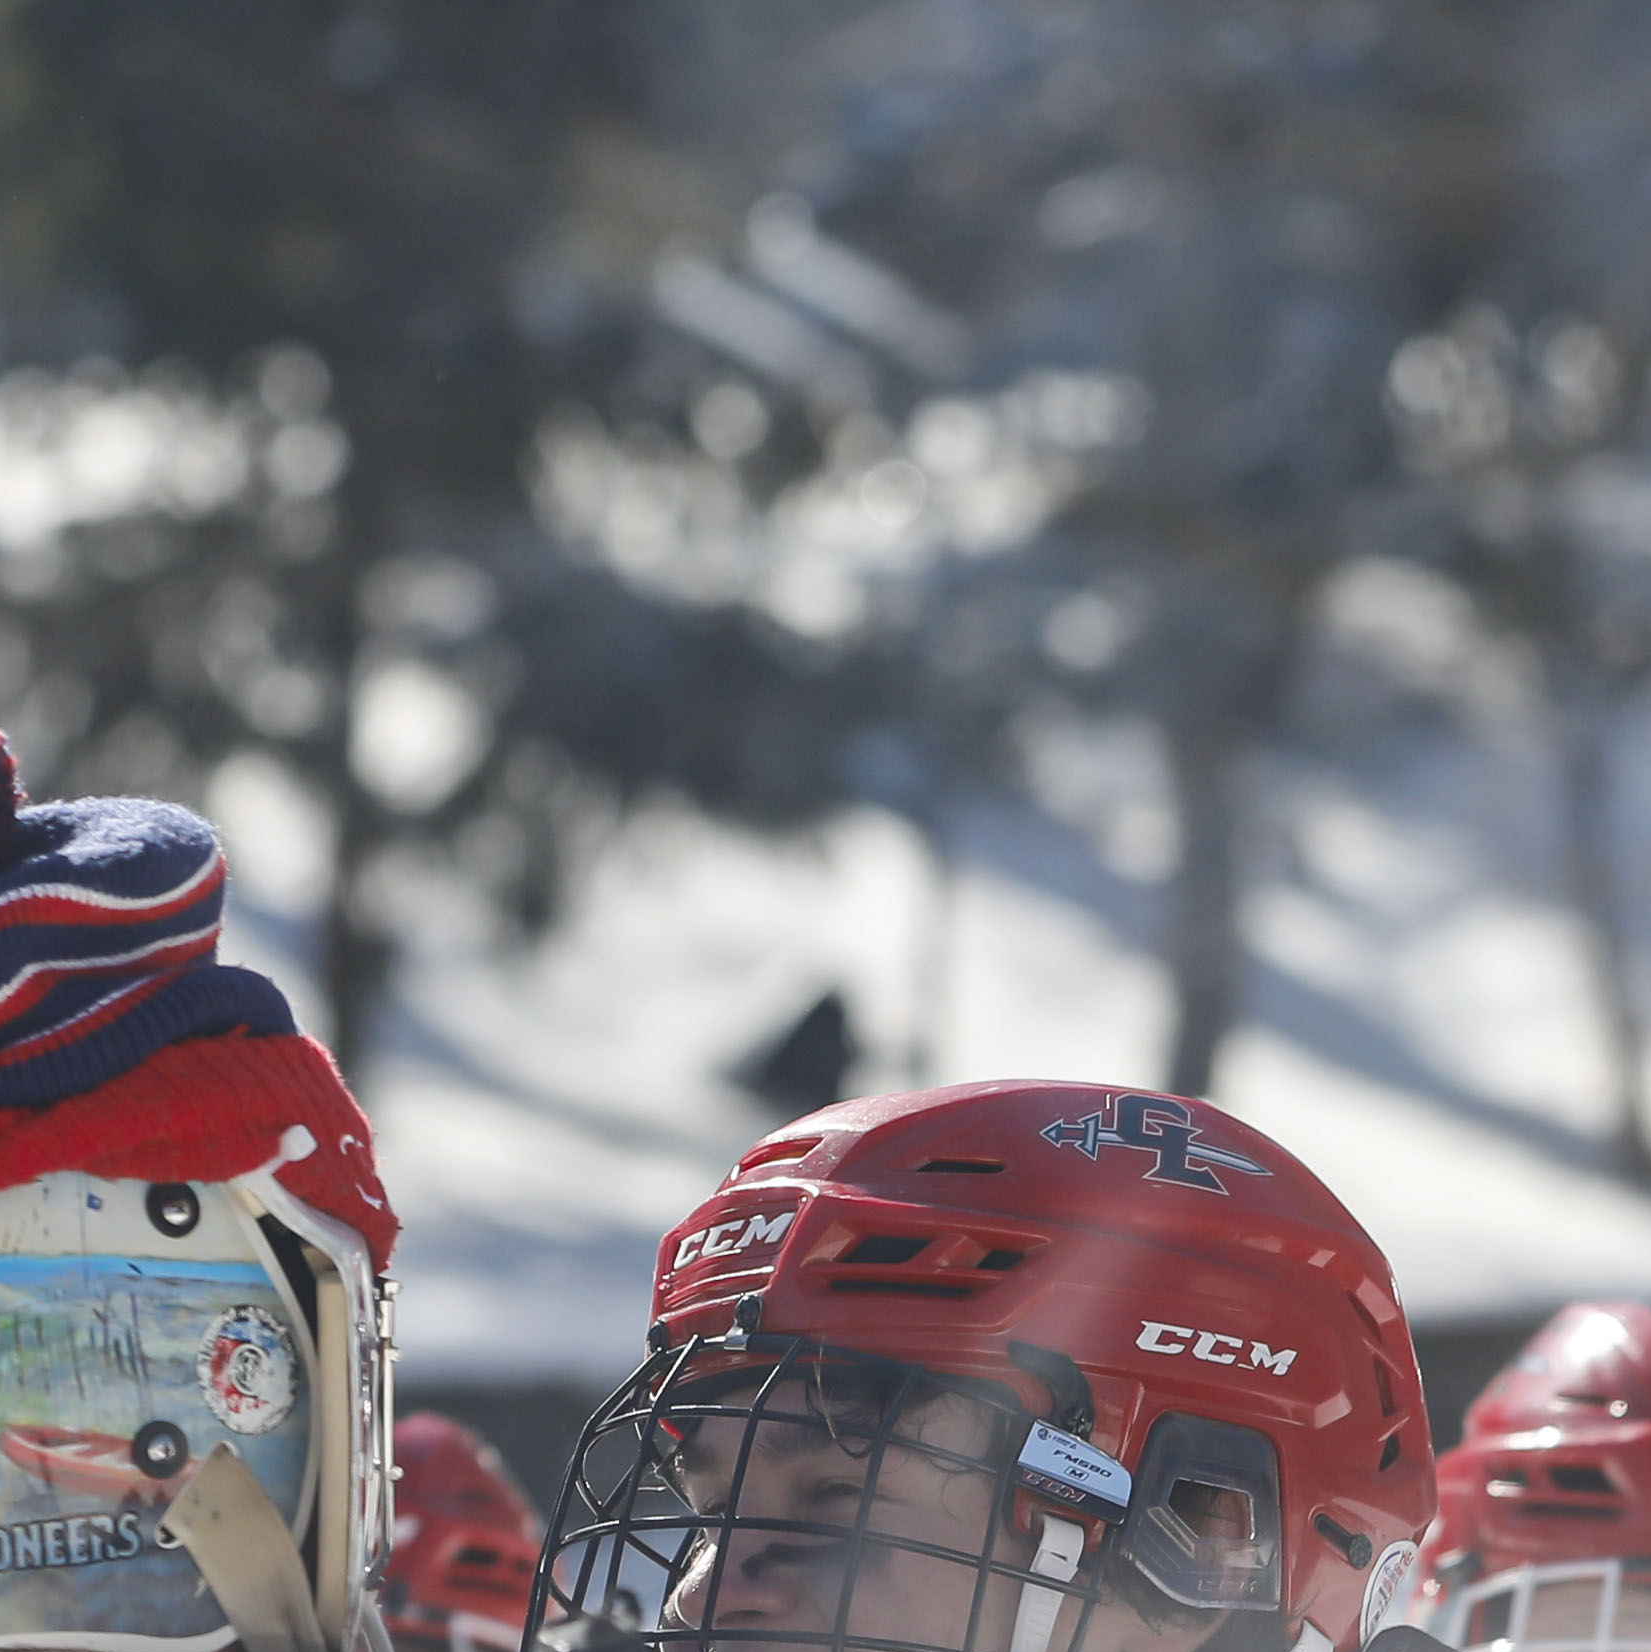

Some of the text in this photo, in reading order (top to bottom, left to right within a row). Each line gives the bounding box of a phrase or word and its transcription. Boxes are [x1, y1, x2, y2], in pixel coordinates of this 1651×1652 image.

[673, 1212, 796, 1270] CCM
[1135, 1320, 1298, 1376] CCM
[1052, 1448, 1113, 1478] FM580
